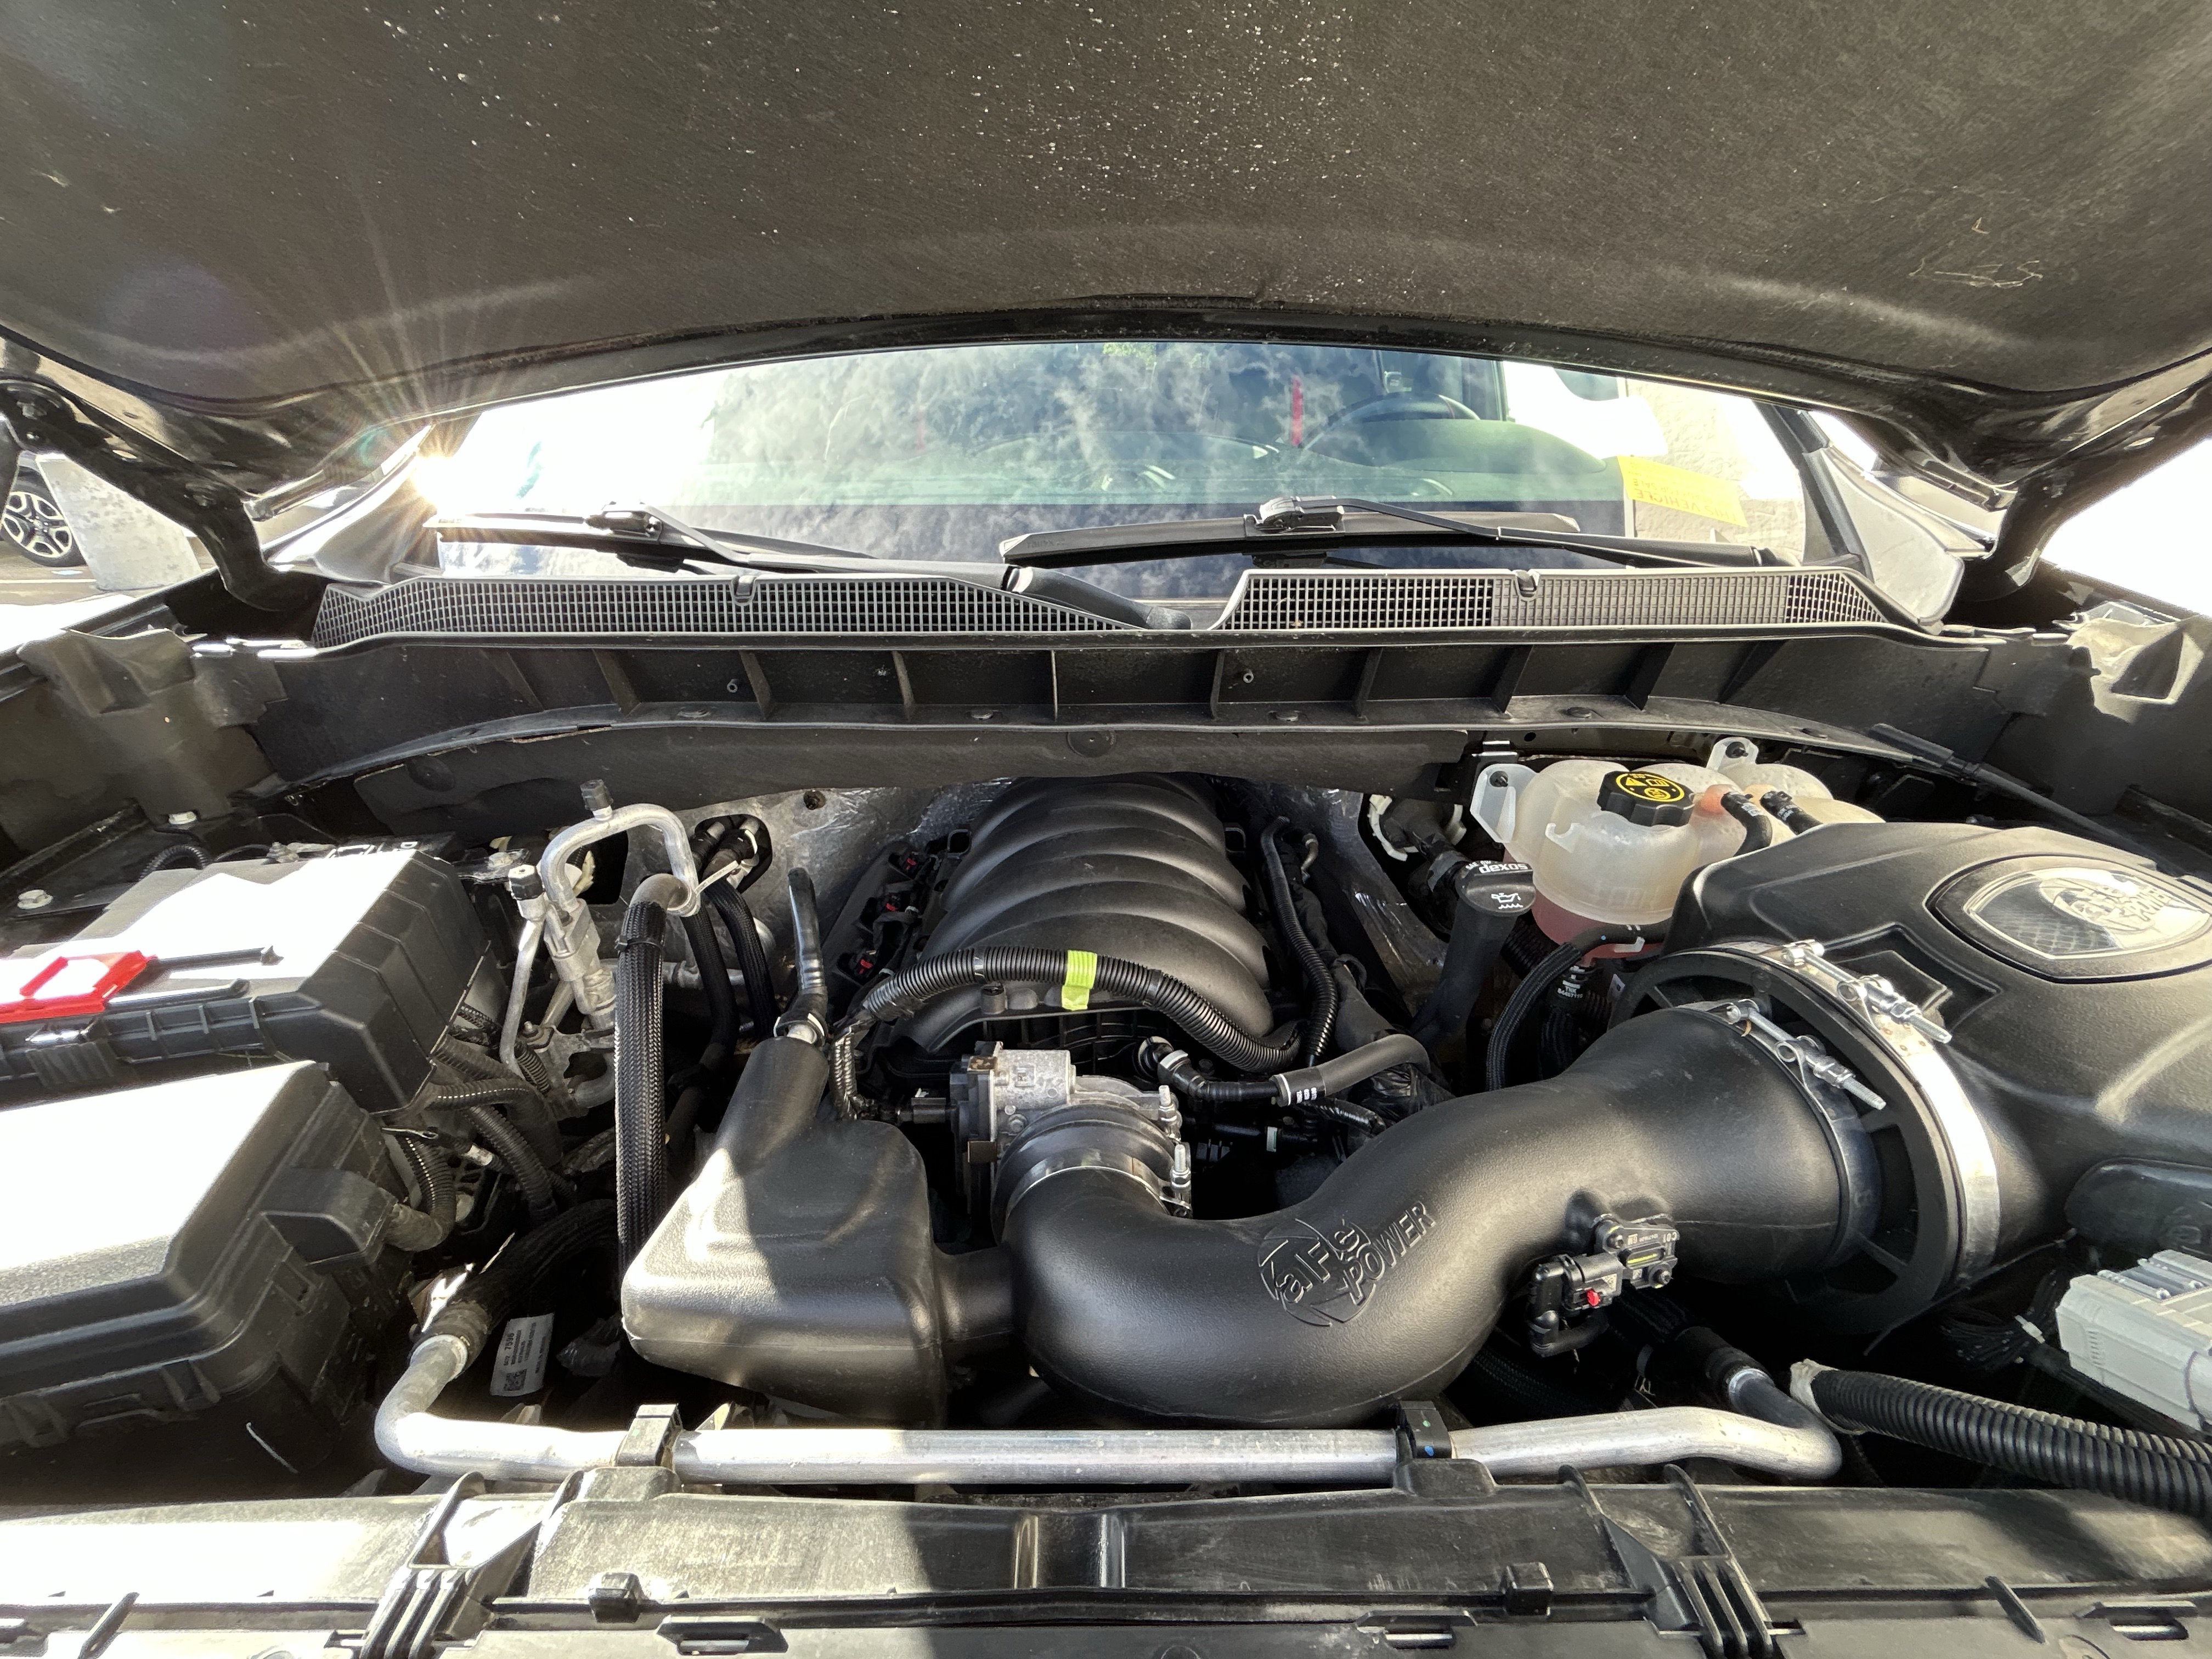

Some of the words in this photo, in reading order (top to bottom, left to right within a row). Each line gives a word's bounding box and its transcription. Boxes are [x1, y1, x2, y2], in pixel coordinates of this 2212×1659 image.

[1633, 478, 1657, 491] SALE
[1634, 488, 1700, 512] VEHICLE
[1704, 505, 1737, 522] THIS
[1479, 863, 1528, 874] dexos
[1343, 1201, 1436, 1306] POWER
